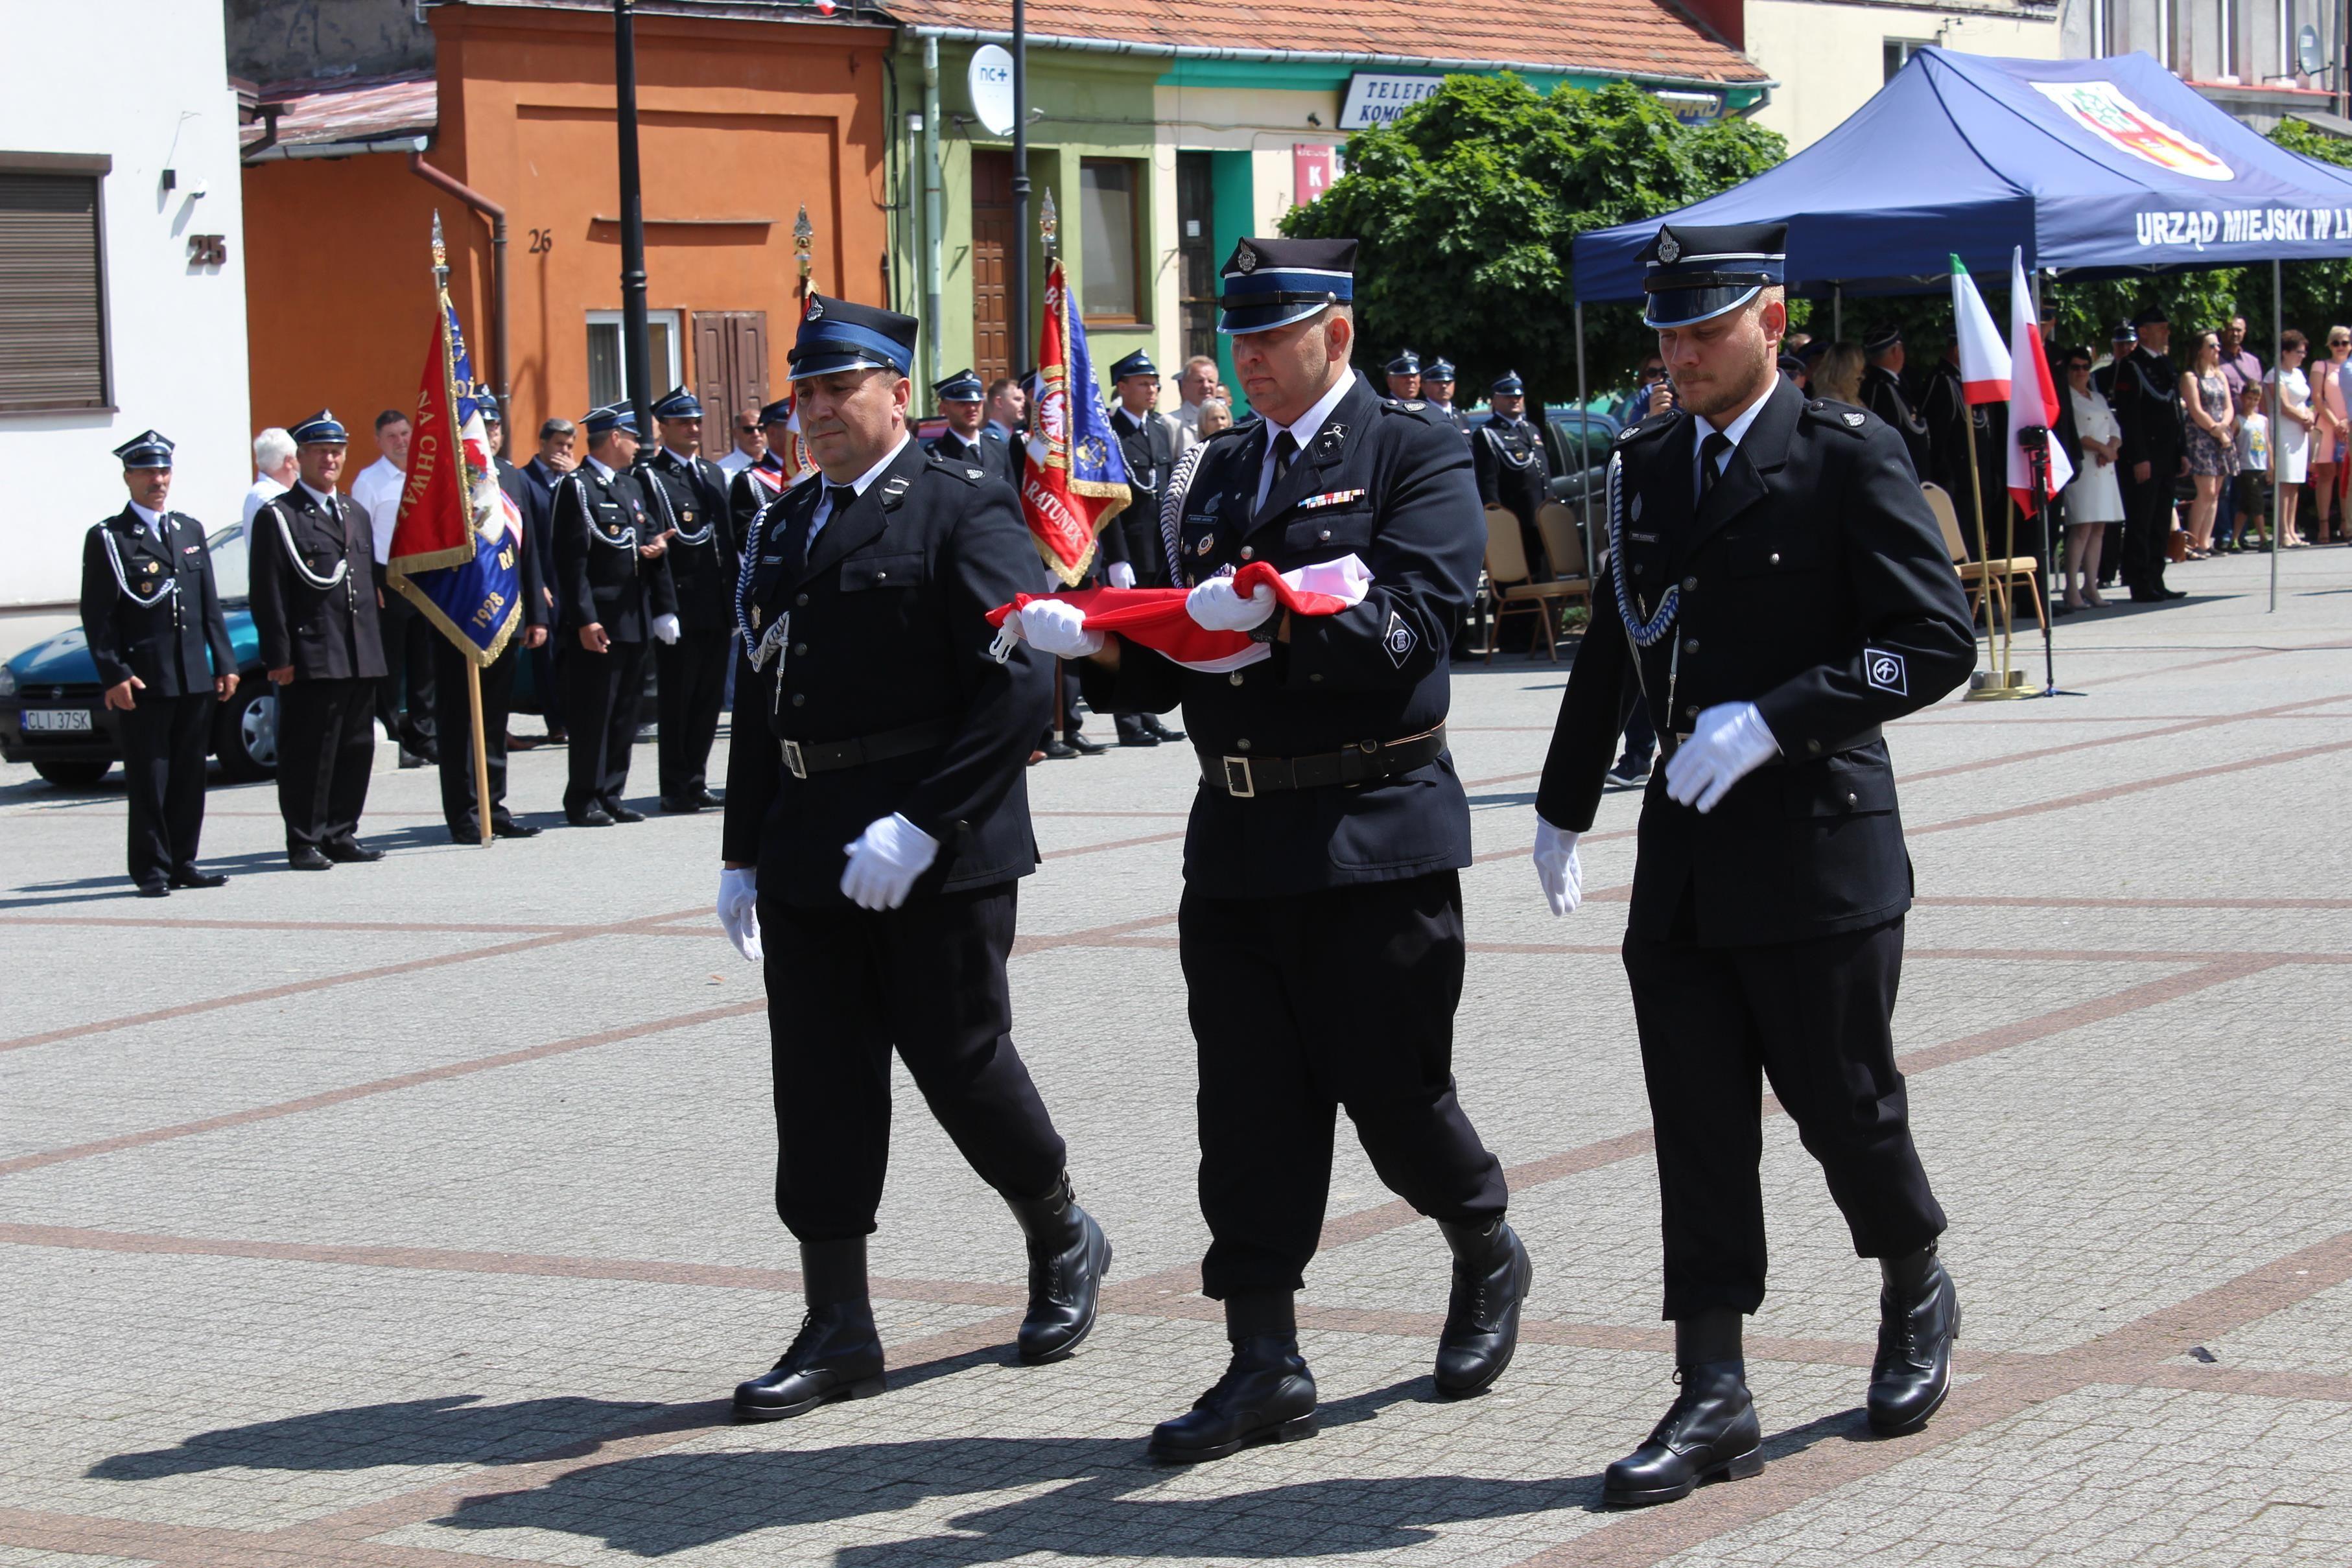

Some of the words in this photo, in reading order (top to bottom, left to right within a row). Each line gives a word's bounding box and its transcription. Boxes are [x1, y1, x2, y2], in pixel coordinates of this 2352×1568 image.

[980, 67, 1007, 82] nc+
[528, 228, 552, 254] 26
[2136, 211, 2218, 252] URZĄD
[2222, 209, 2307, 242] MIEJSKI
[2312, 209, 2331, 240] W
[189, 235, 226, 265] 25
[417, 389, 435, 426] NA
[1025, 481, 1085, 548] RATUNEK
[471, 591, 505, 629] 1928
[28, 712, 51, 729] CLI
[57, 712, 89, 729] 37SK
